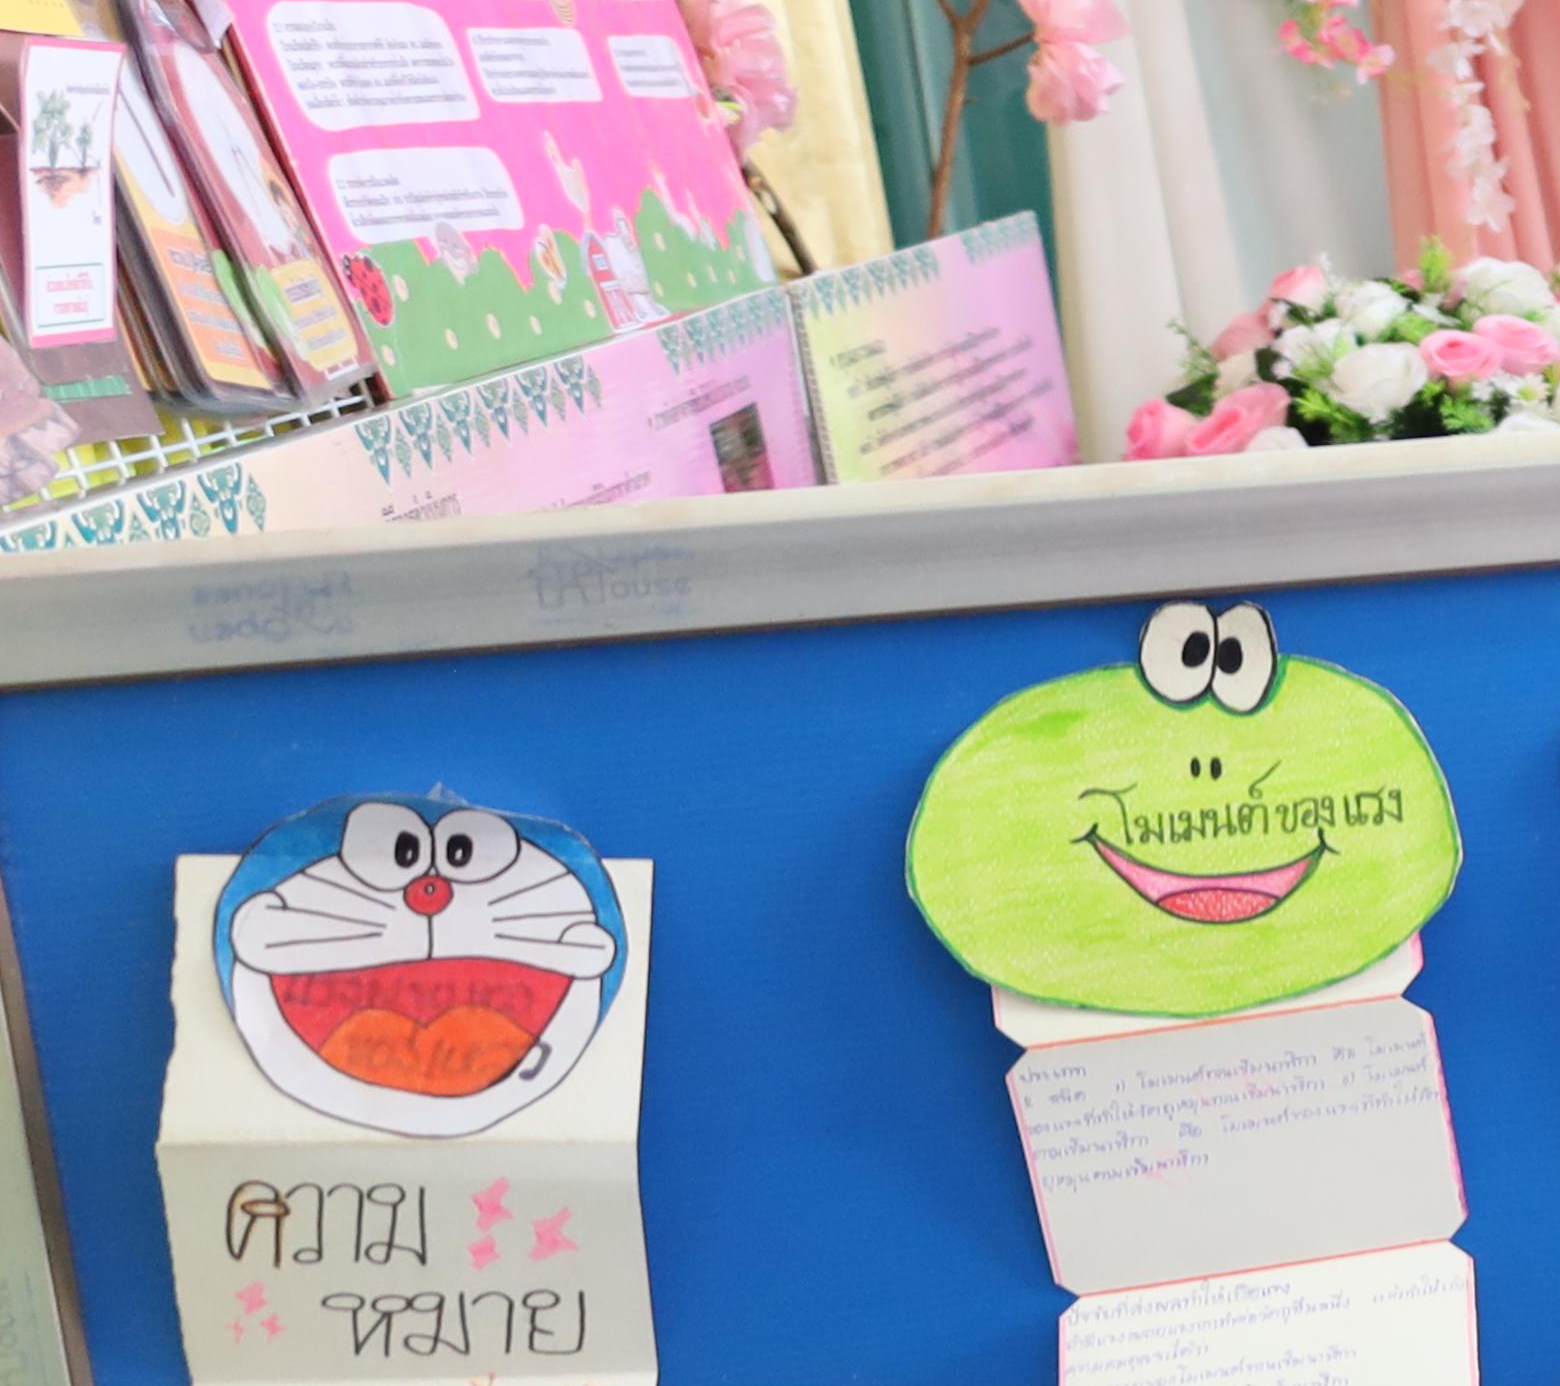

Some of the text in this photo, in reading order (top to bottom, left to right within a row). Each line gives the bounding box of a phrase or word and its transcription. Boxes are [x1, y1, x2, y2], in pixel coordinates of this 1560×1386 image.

[1078, 760, 1403, 846] โมเมนต์ของแรง
[224, 1180, 428, 1269] ความ
[321, 1289, 588, 1358] หมาย
